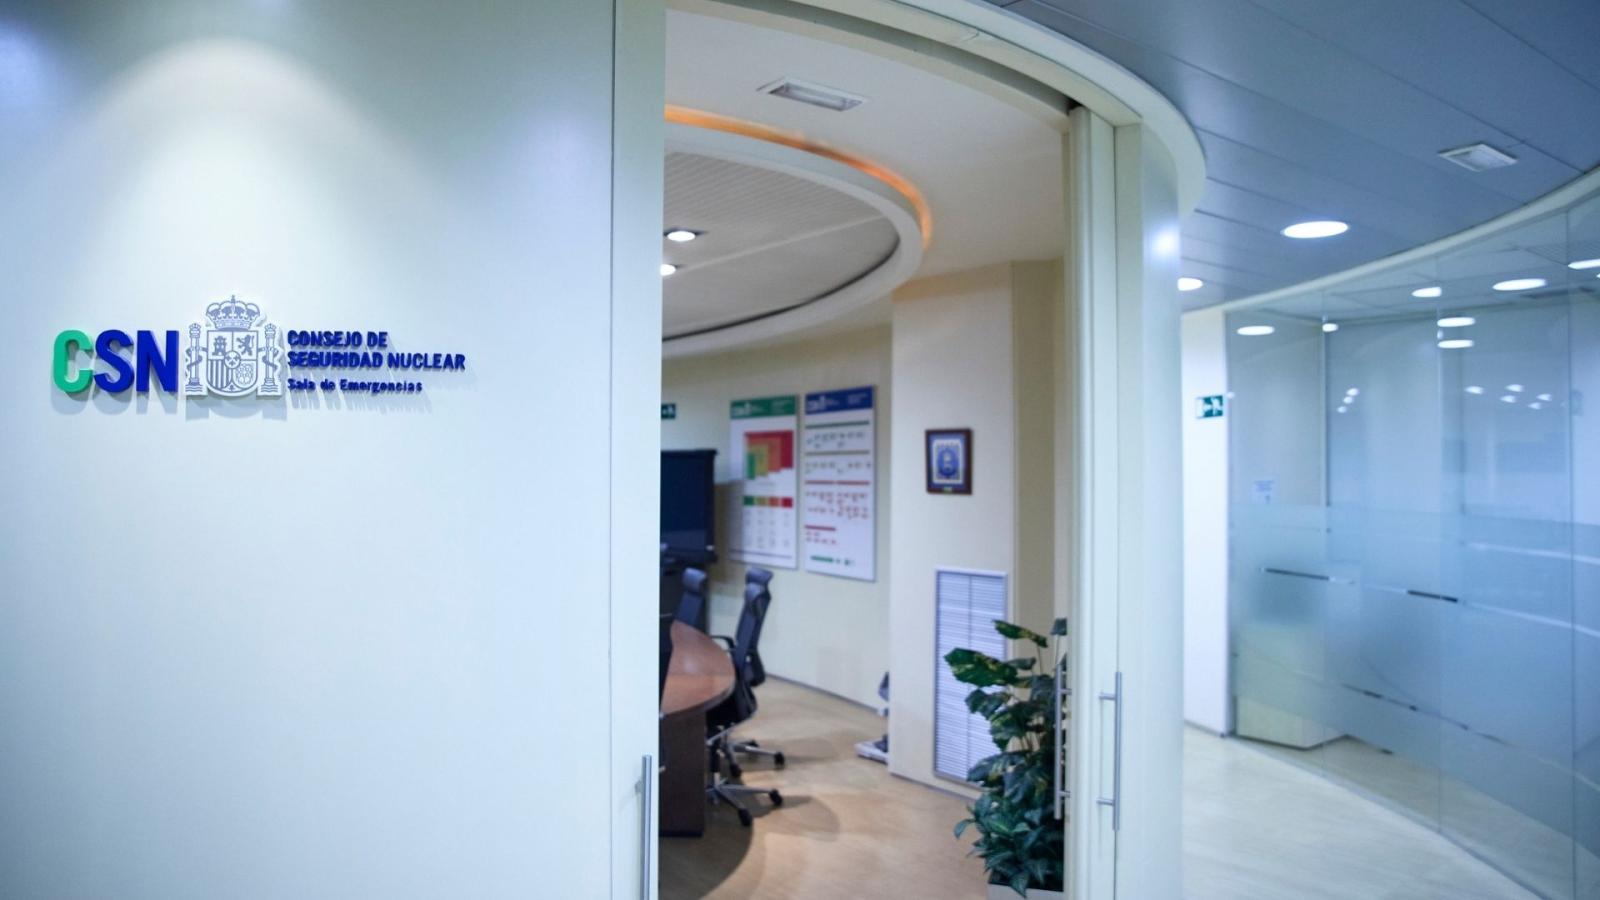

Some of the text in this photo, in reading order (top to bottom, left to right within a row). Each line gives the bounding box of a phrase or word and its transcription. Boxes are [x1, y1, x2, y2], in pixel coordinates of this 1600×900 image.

[287, 330, 388, 347] CONSEJO DE
[53, 329, 179, 393] CSN
[287, 351, 466, 370] SEGURIDAD NUCLEAR
[287, 378, 423, 393] Sala de Emergencias
